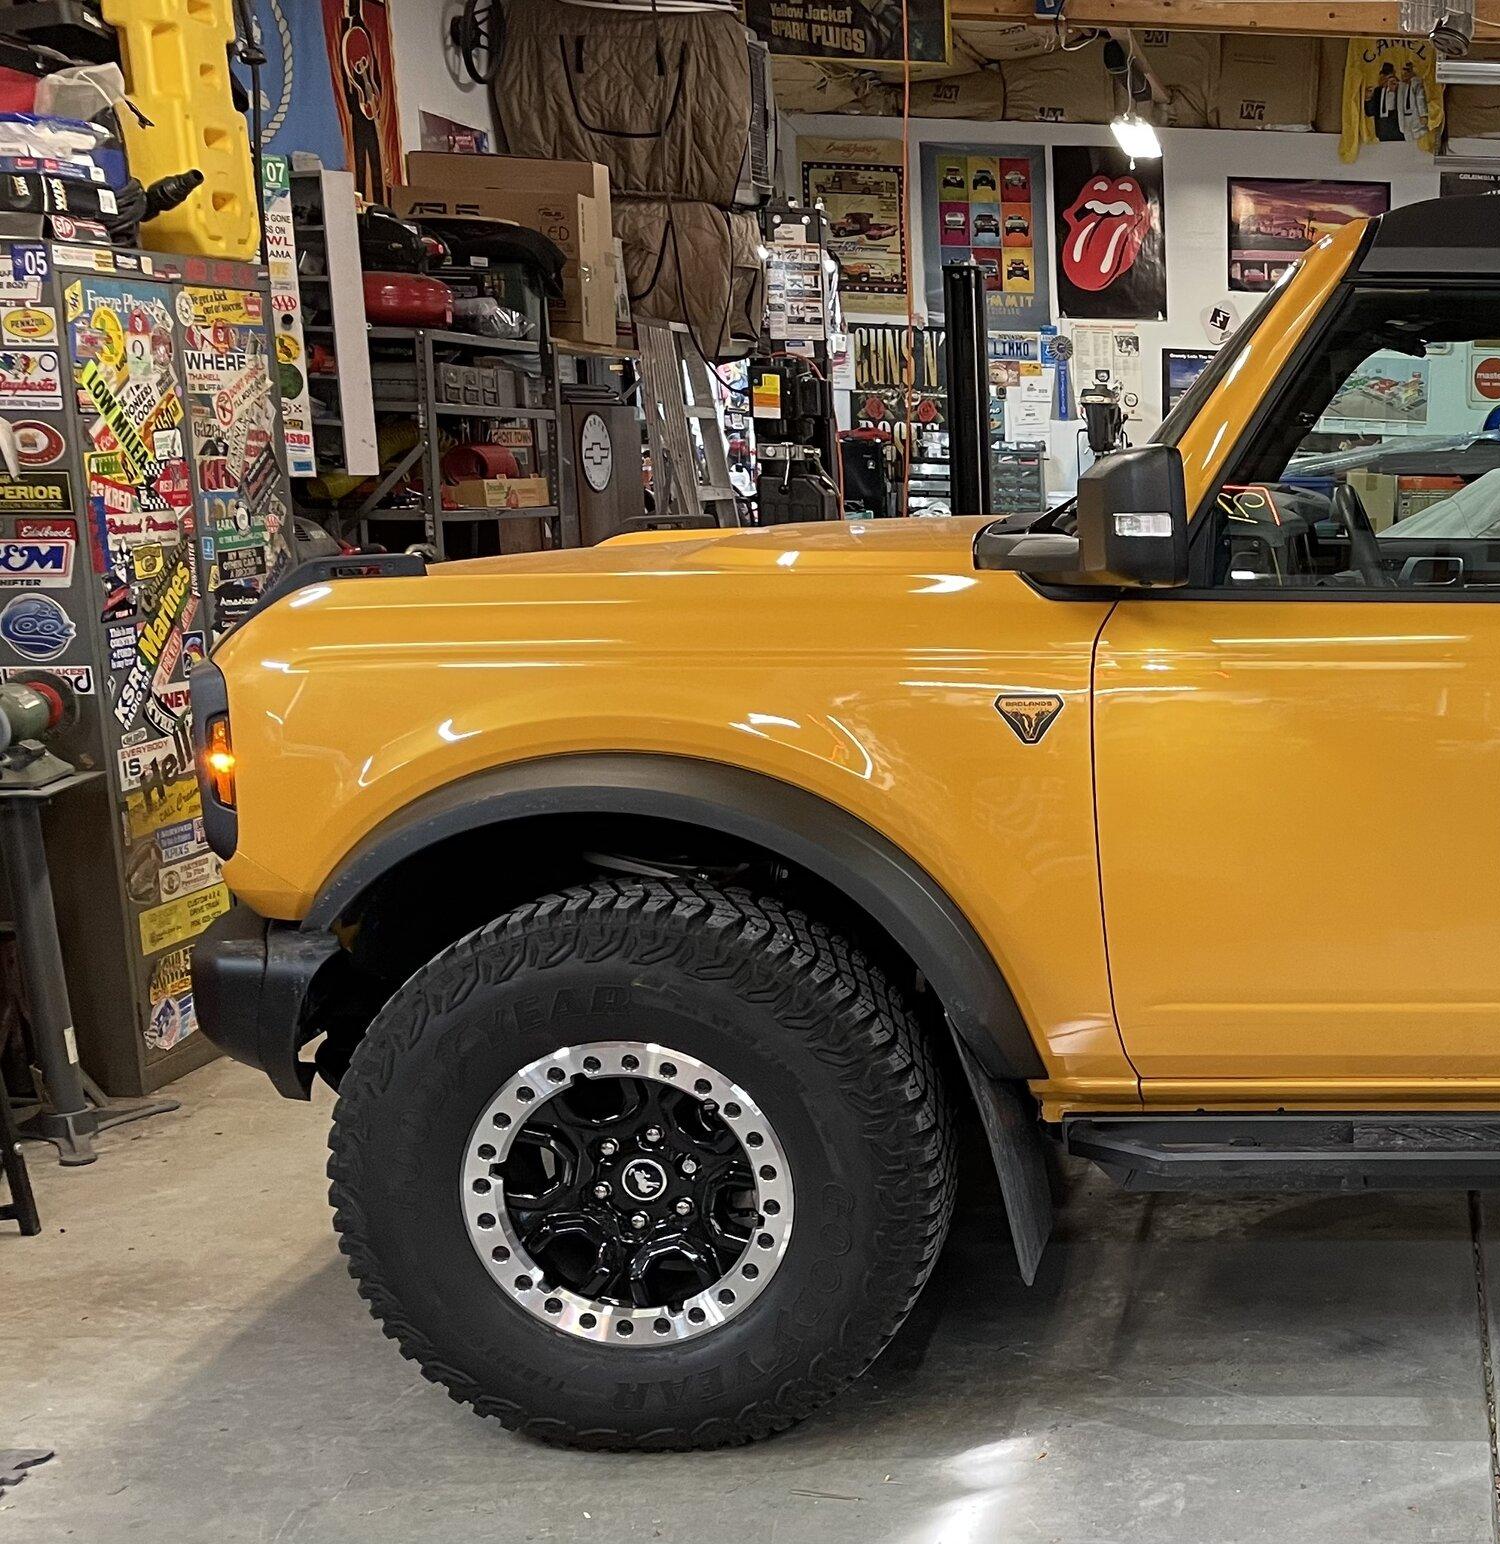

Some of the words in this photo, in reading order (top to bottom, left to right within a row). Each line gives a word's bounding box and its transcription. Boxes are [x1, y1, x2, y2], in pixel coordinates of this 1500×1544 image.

[769, 3, 803, 18] Yellow
[805, 5, 853, 24] Jacket
[771, 20, 810, 41] SPARK
[812, 24, 865, 53] PLUGS
[266, 162, 285, 182] 07
[270, 214, 291, 224] GONE
[24, 251, 47, 275] 05
[989, 296, 1035, 310] MMIT
[11, 318, 46, 328] PENNZOIL
[855, 328, 915, 386] GUNS
[86, 370, 117, 416] LOW
[111, 410, 149, 472] MILEA
[21, 526, 72, 539] Edelbrock
[220, 596, 259, 607] American
[137, 561, 191, 666] Marines
[123, 690, 143, 732] RADIO
[120, 740, 169, 760] EVERYBODY
[123, 757, 141, 779] IS
